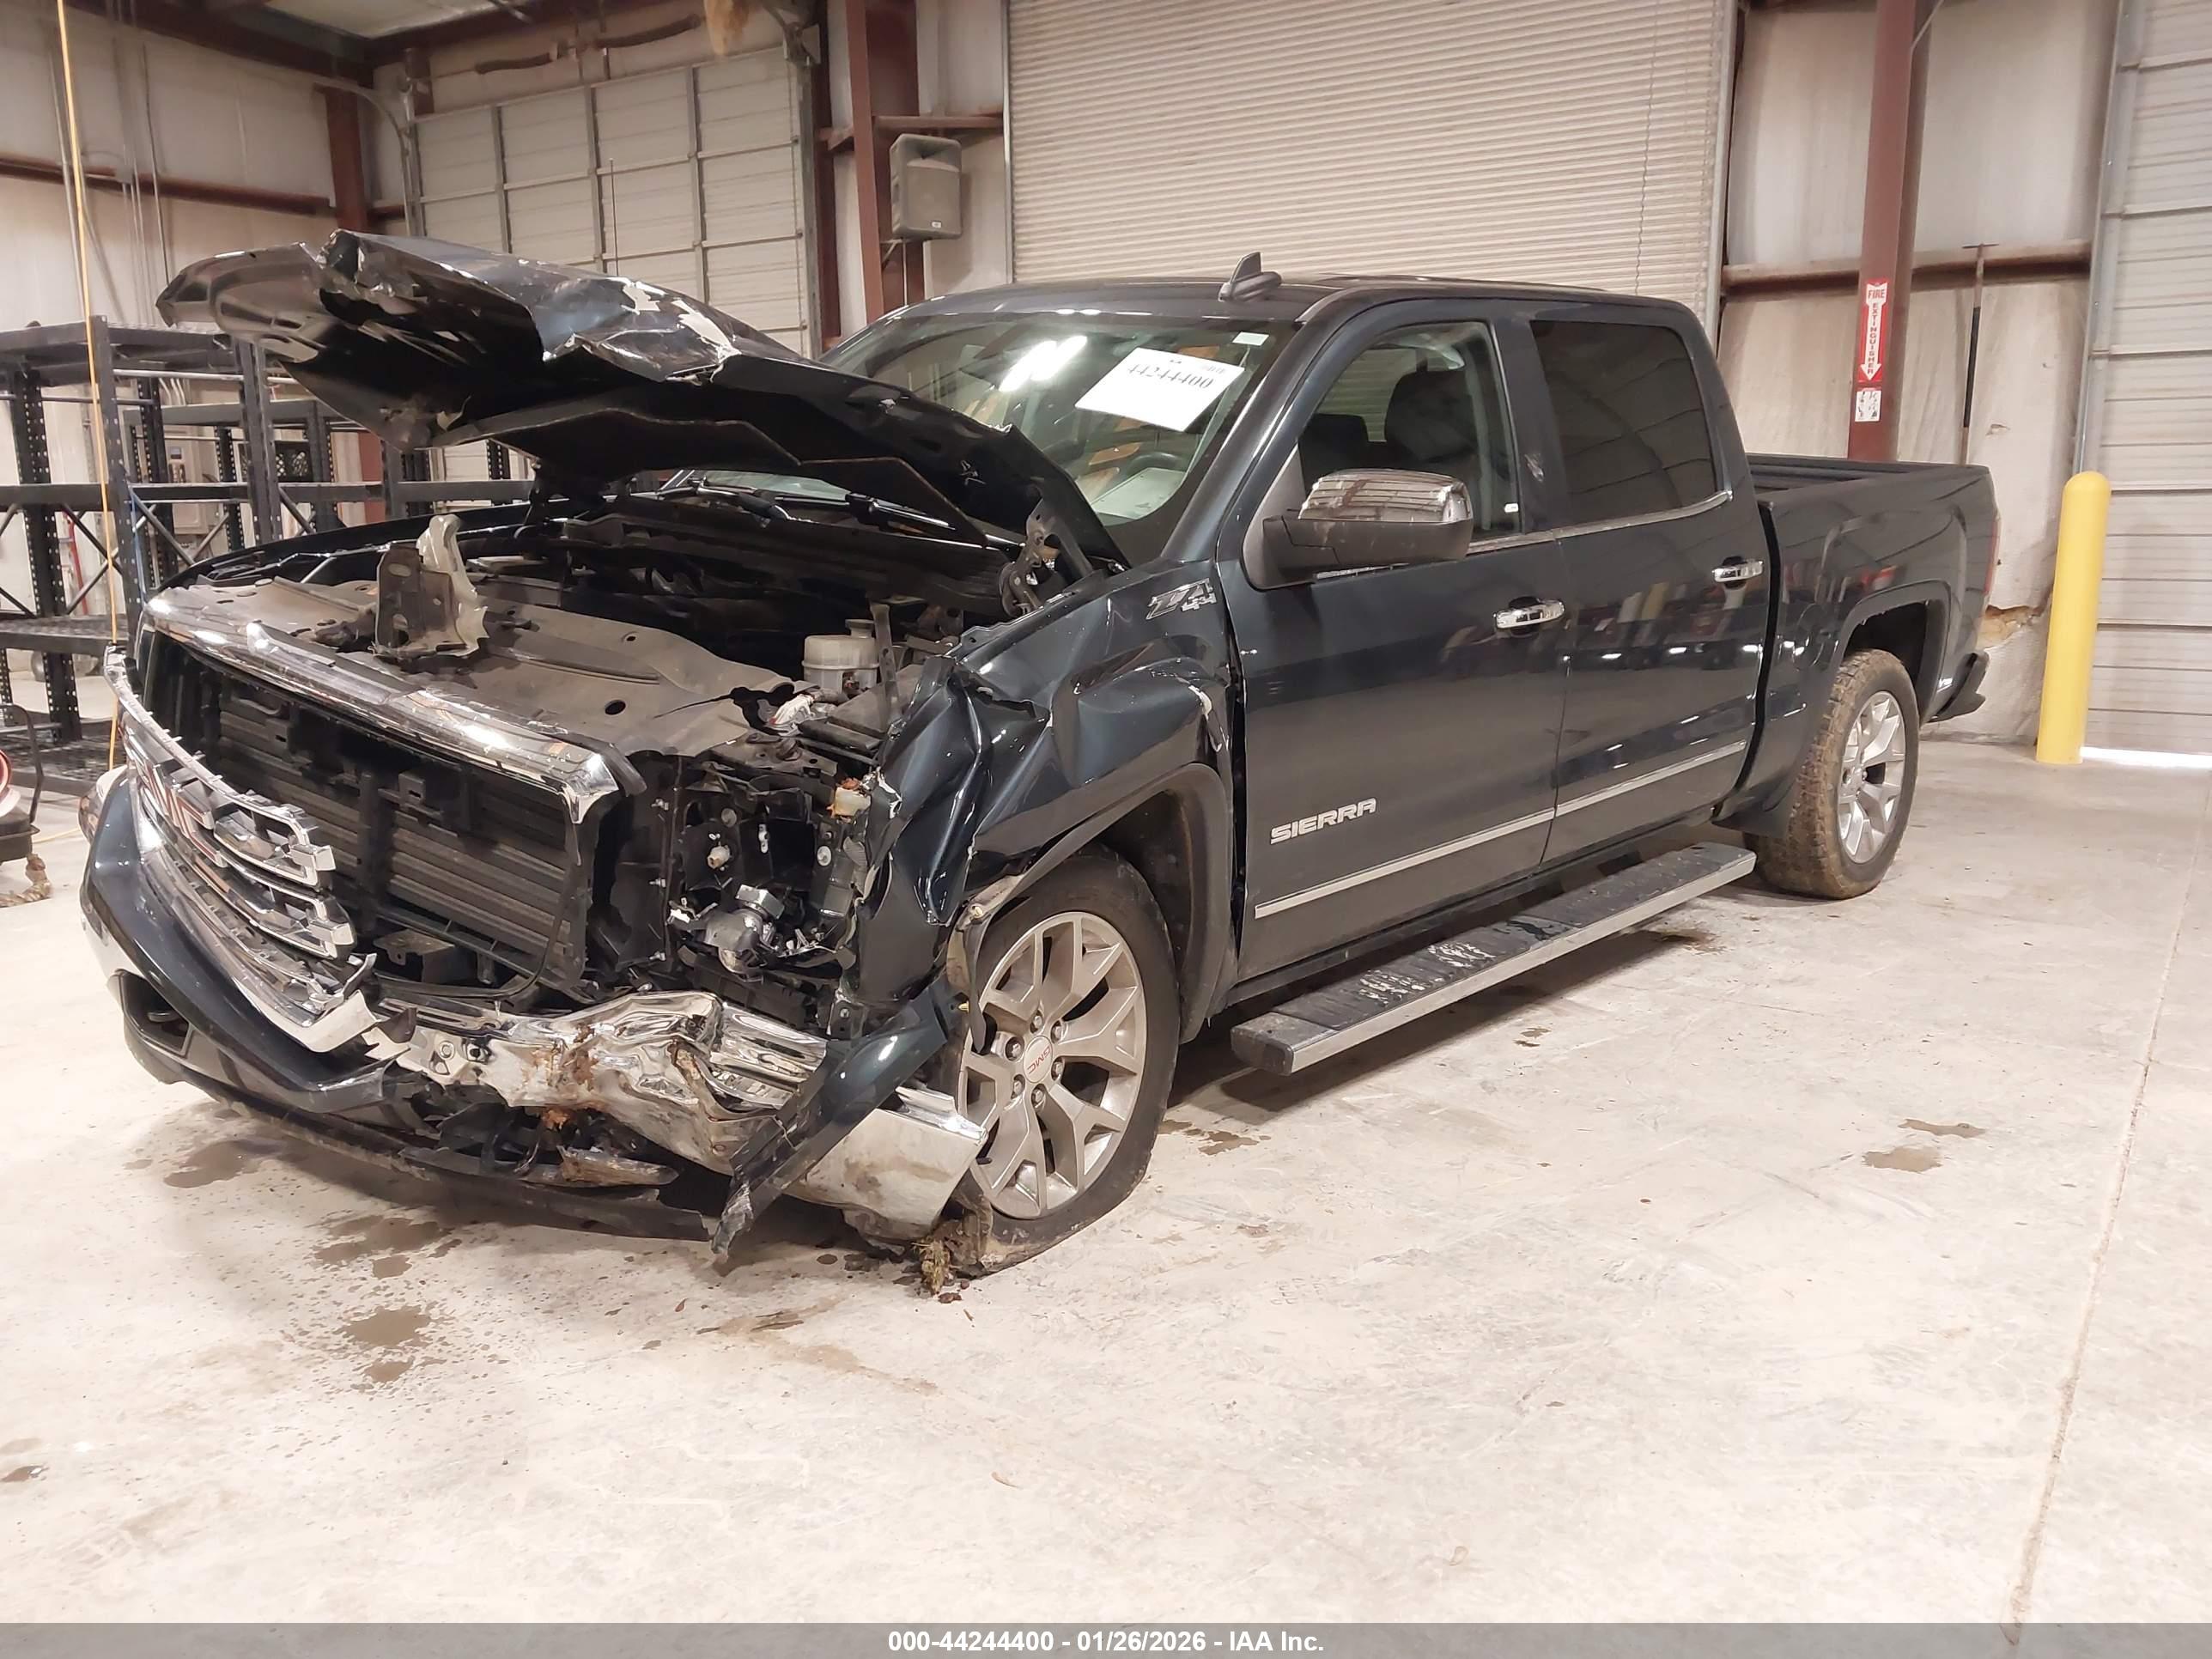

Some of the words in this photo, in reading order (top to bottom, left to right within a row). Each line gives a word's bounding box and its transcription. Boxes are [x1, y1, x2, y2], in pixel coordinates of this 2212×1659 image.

[1868, 289, 1885, 300] FIRE
[1867, 302, 1878, 374] EXTINGUISHER
[1270, 797, 1376, 845] SIERRA
[1026, 1045, 1051, 1075] GMC
